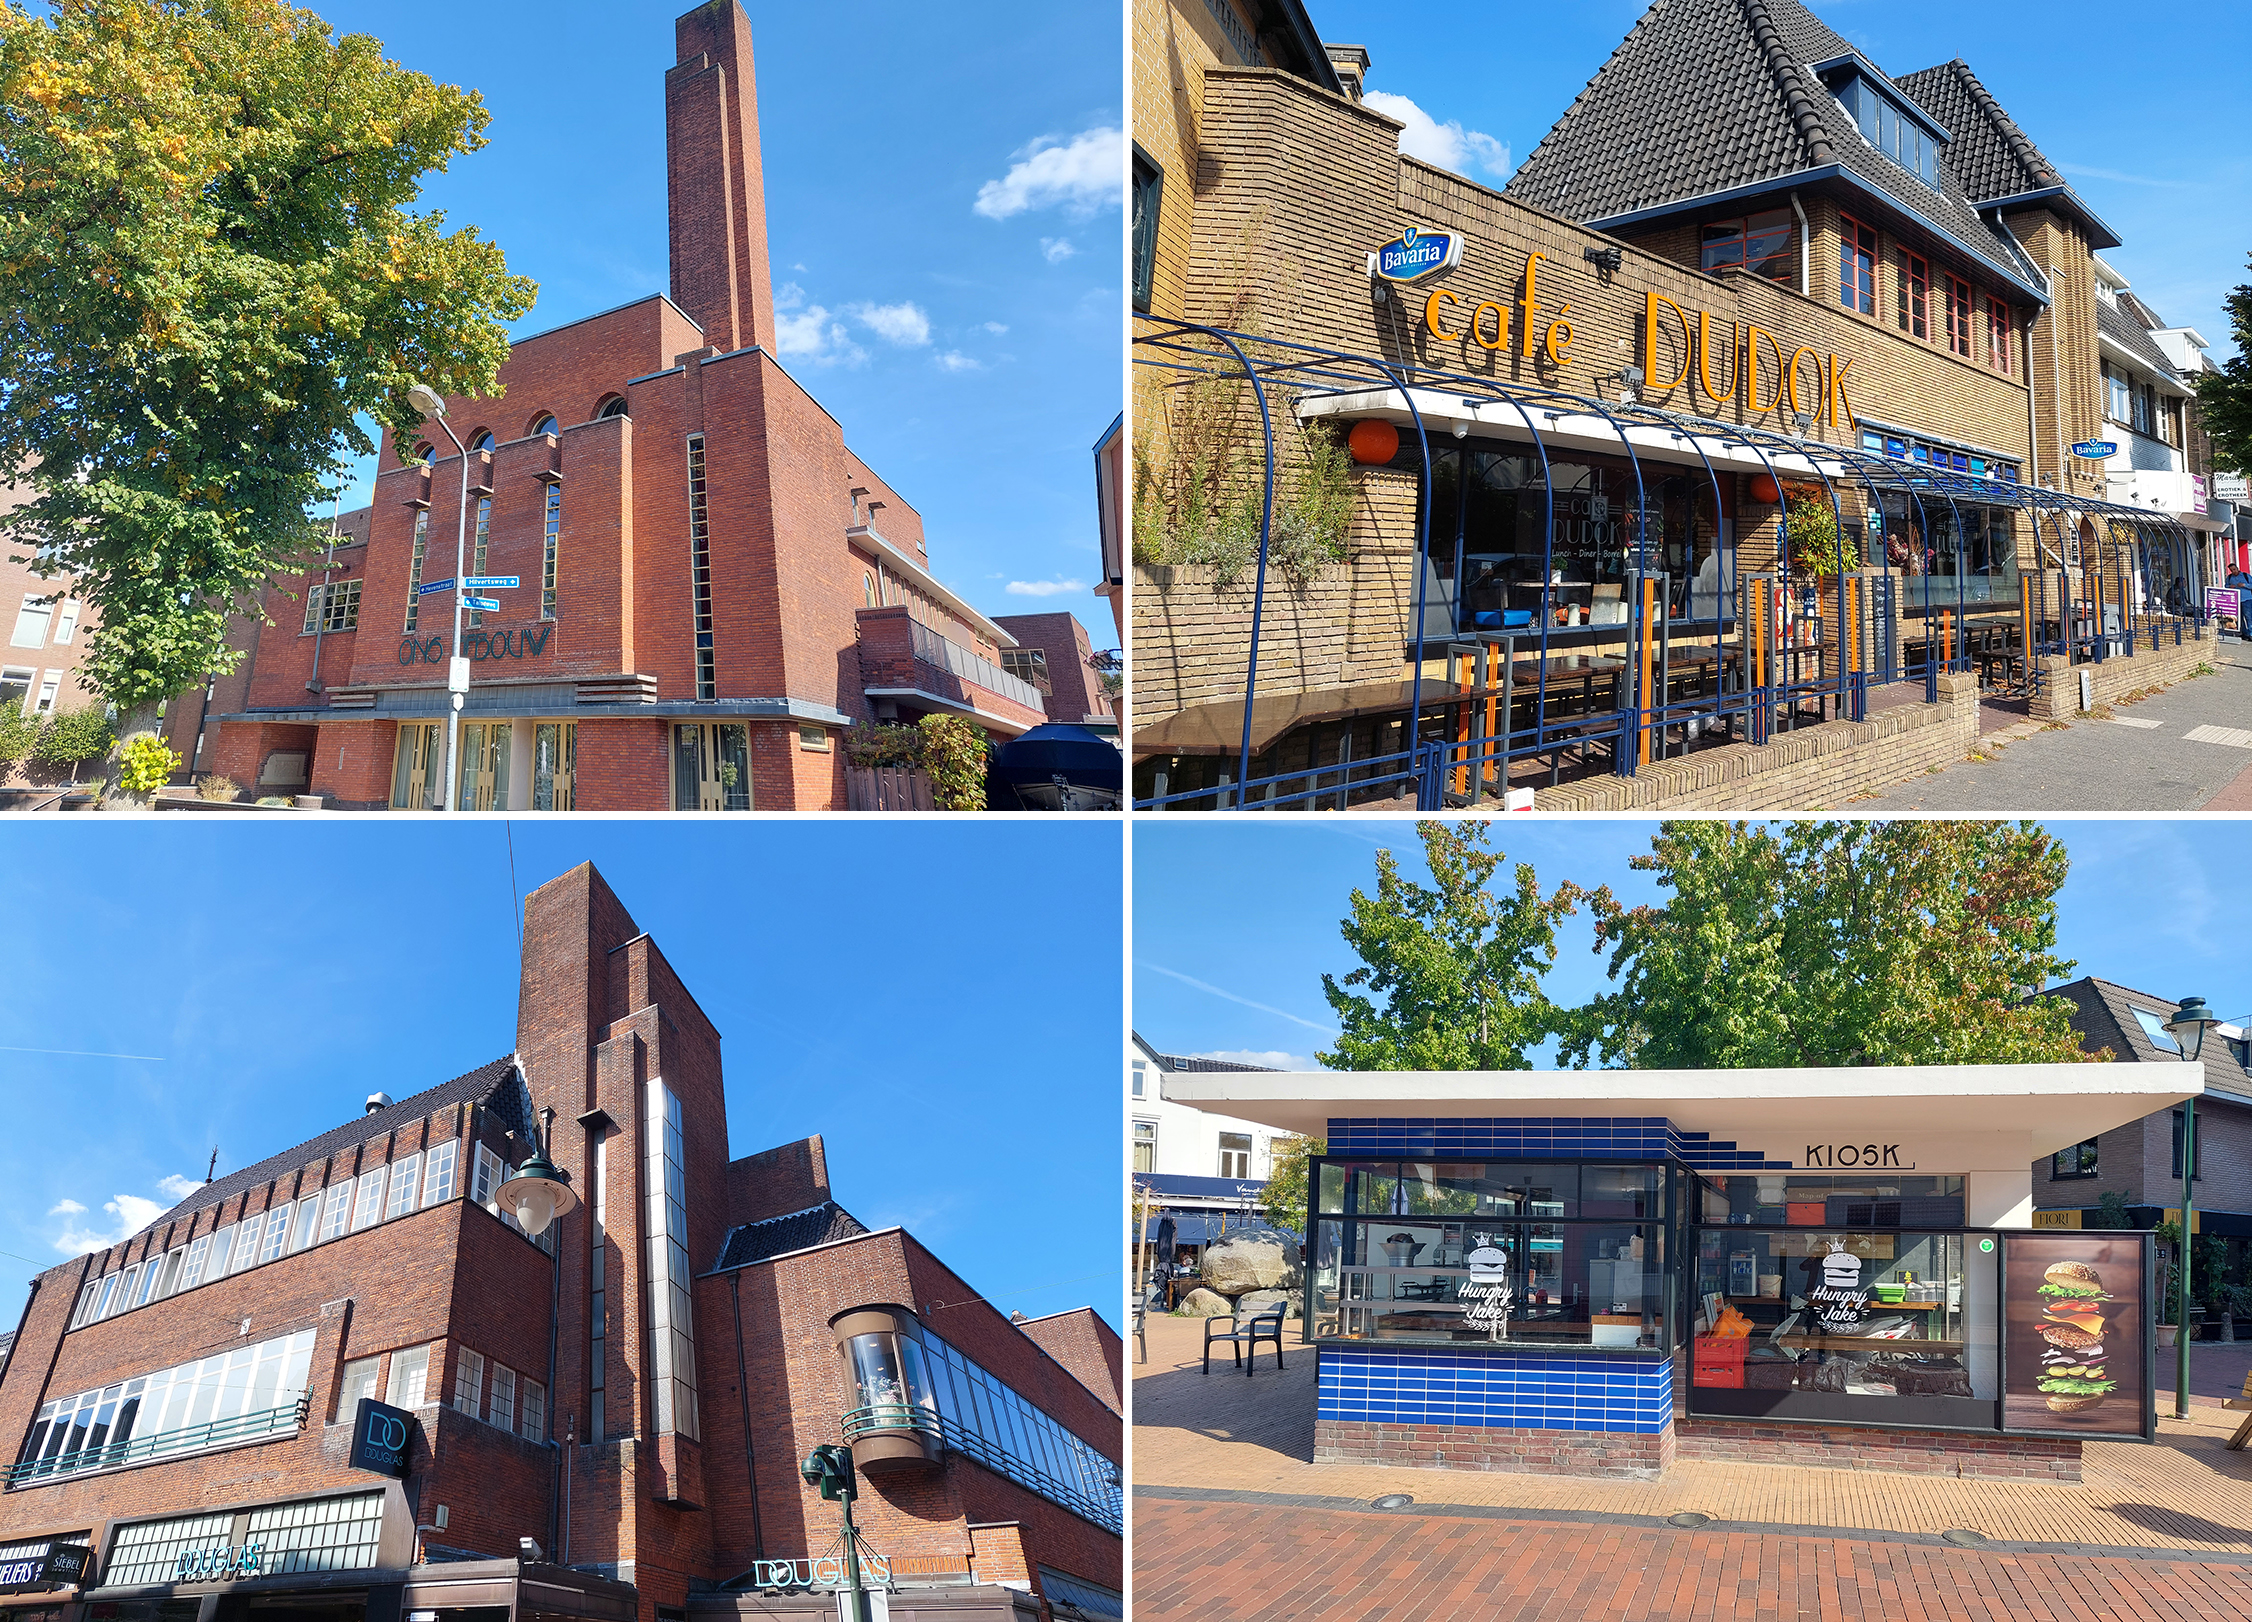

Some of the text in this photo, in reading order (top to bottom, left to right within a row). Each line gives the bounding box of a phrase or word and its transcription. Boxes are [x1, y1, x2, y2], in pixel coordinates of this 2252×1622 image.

[1384, 243, 1441, 270] Bavaria
[1425, 251, 1856, 432] café DUDOK
[2076, 445, 2113, 455] Bavaria
[1553, 519, 1622, 545] DUDOK
[1552, 549, 1572, 558] Lunch
[1579, 549, 1597, 558] Diner
[468, 578, 507, 586] Hilvertsweg
[399, 628, 550, 665] ONS EBOUW
[1806, 1144, 1900, 1167] KIOSK
[2039, 1213, 2069, 1226] FIORI
[1458, 1281, 1513, 1307] Hungry
[1812, 1285, 1868, 1309] Hungry
[1466, 1302, 1503, 1319] Jake
[1820, 1306, 1858, 1322] Jake
[367, 1411, 406, 1451] DO
[364, 1447, 404, 1467] DOUGLAS
[53, 1557, 80, 1570] SIEBEL
[175, 1543, 260, 1575] DOUGLAS
[754, 1556, 892, 1588] DOUGLAS
